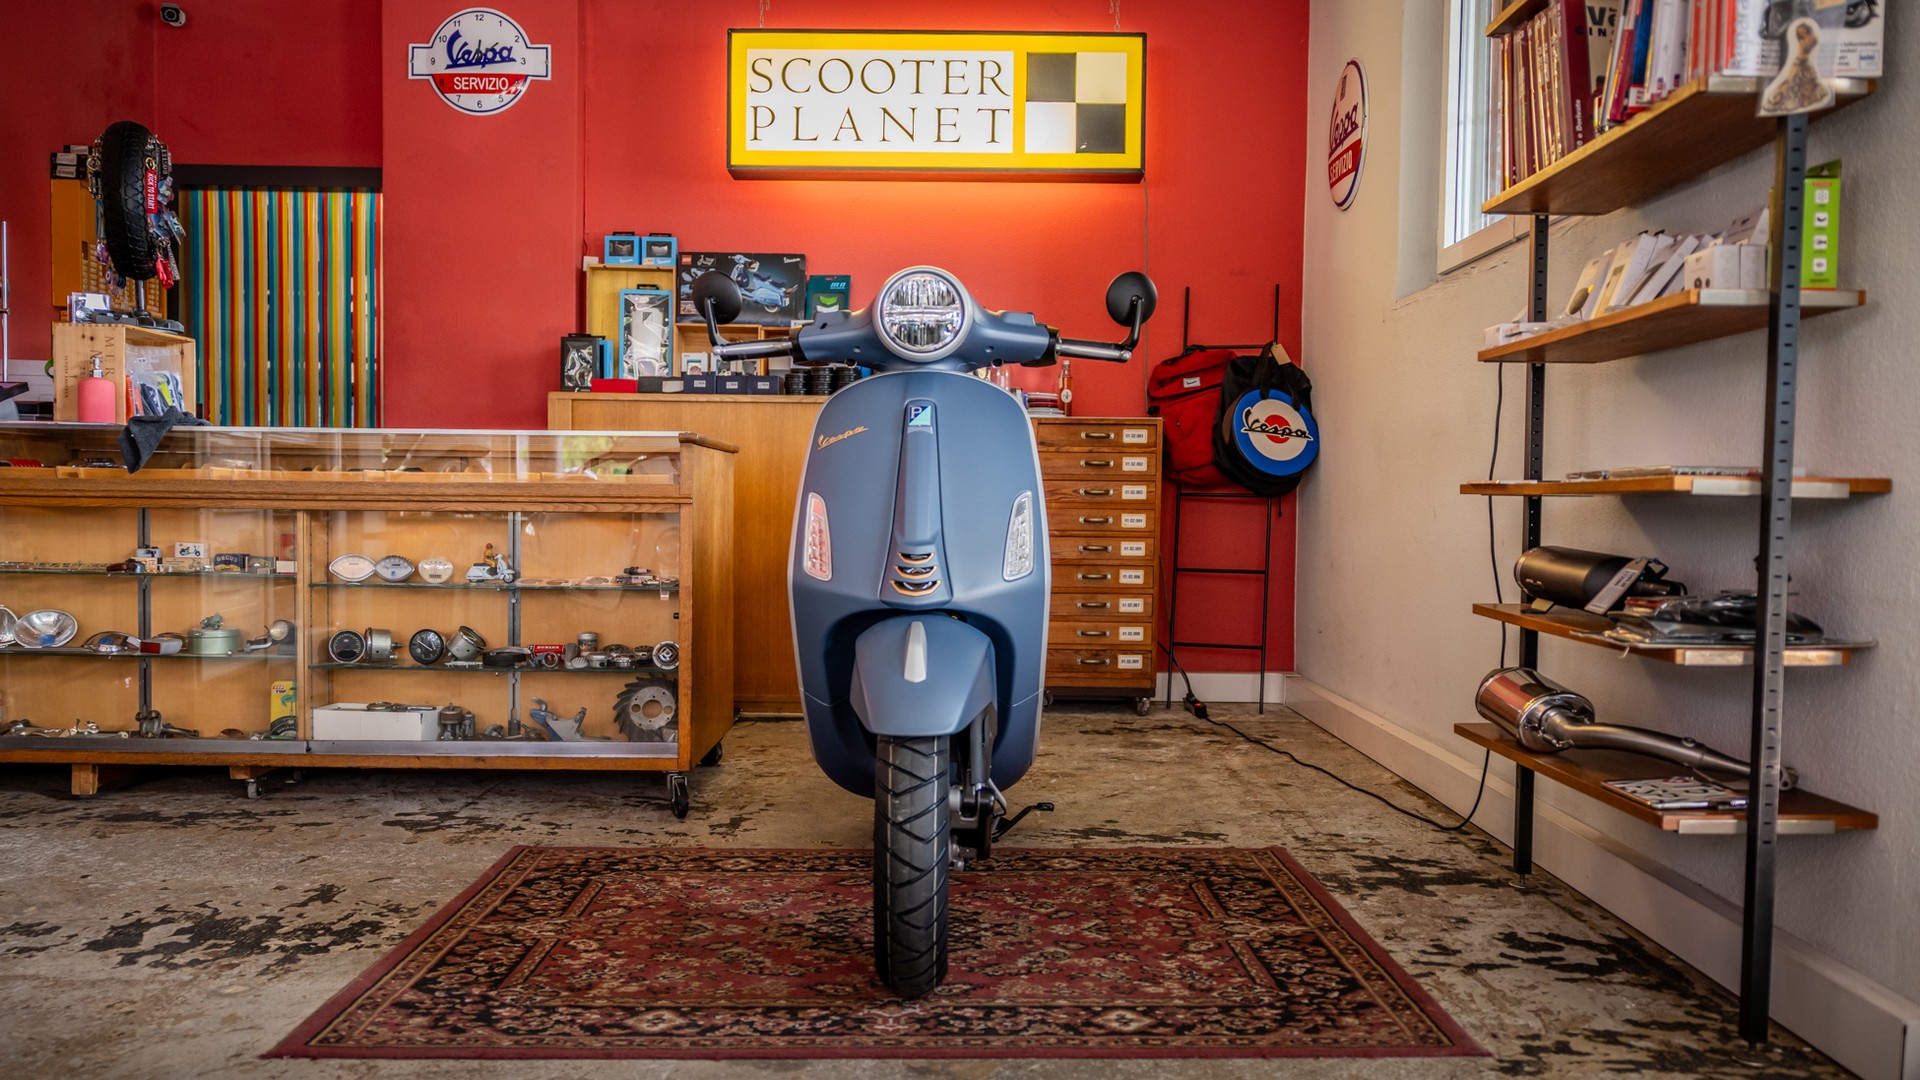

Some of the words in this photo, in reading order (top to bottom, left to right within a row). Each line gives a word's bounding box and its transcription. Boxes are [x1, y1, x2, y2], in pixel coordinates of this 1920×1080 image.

[438, 35, 447, 43] 10
[444, 29, 517, 70] Vespa
[430, 57, 436, 65] 9
[520, 57, 526, 65] 3
[453, 77, 509, 91] SERVIZIO
[749, 57, 1011, 98] SCOOTER
[477, 100, 483, 109] 6
[498, 95, 504, 103] 5
[749, 105, 1011, 144] PLANET
[1328, 101, 1359, 159] Vespa
[1329, 149, 1353, 184] SERVIZIO
[147, 193, 155, 210] START
[1242, 408, 1312, 440] Vespa
[818, 426, 869, 450] Vespa
